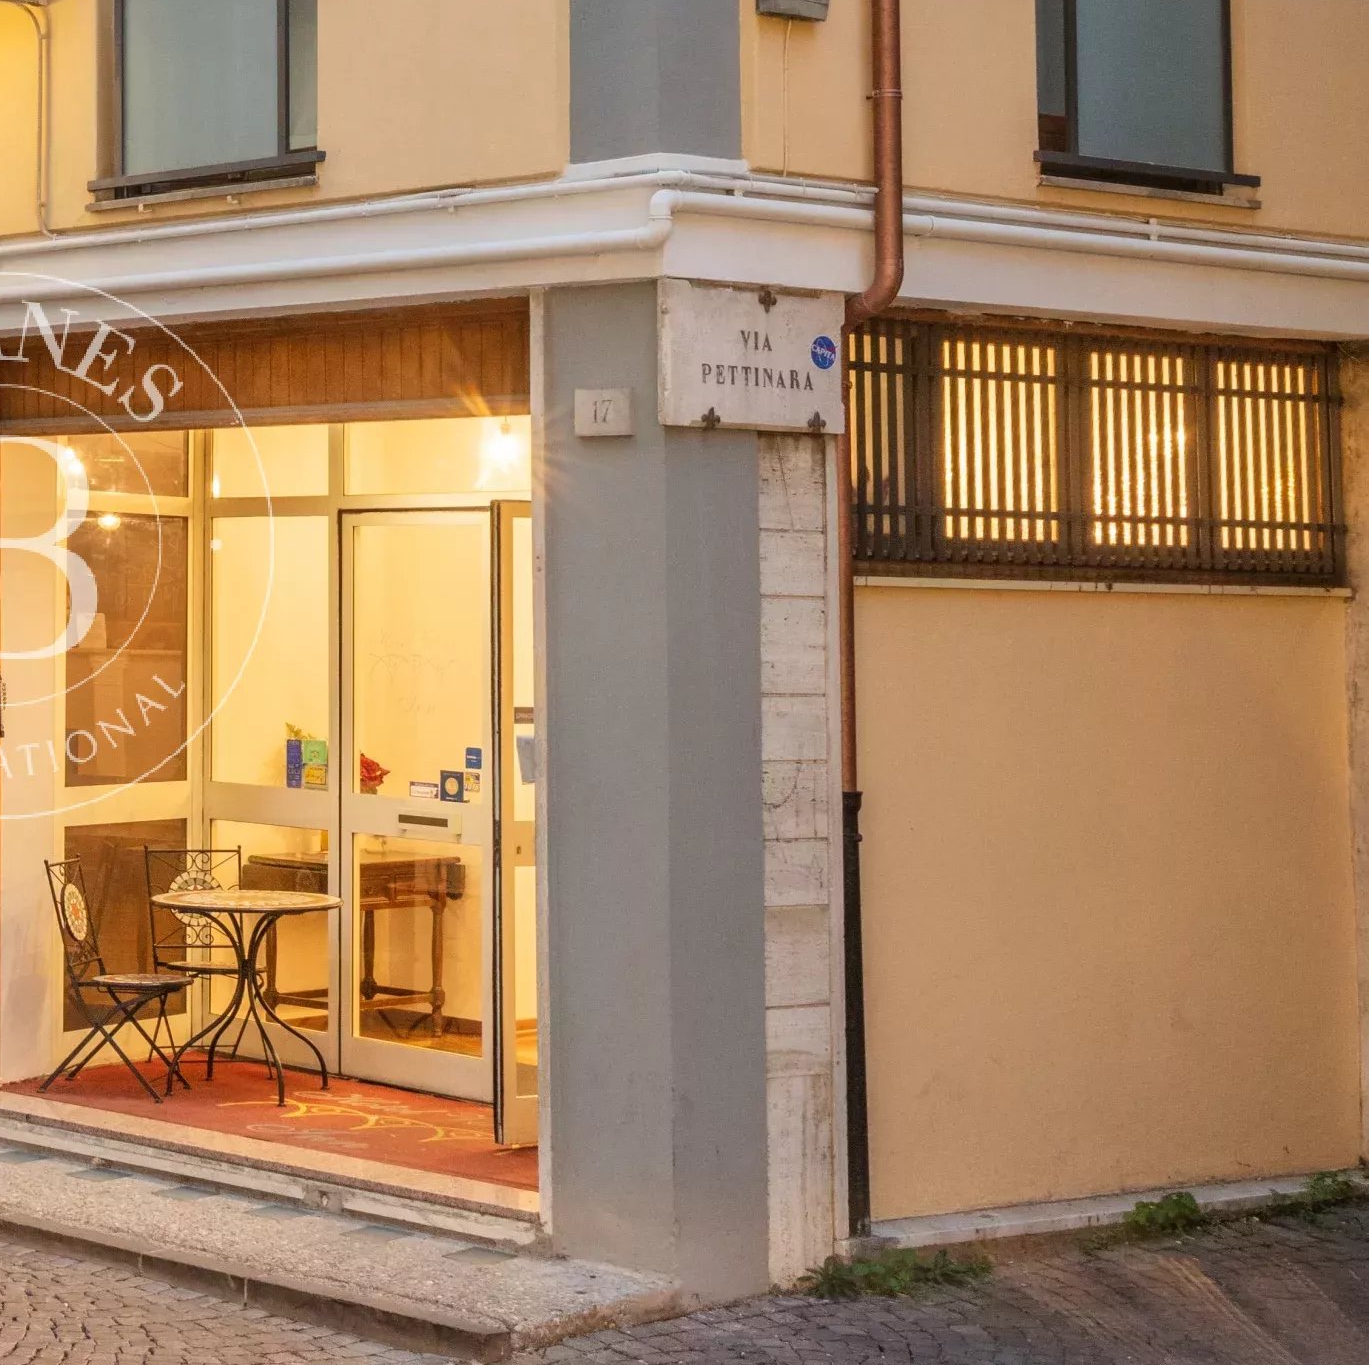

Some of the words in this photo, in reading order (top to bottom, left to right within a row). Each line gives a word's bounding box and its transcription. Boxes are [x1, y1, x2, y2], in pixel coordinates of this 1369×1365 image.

[740, 329, 773, 352] VIA
[701, 363, 814, 391] PETTINARA
[592, 399, 613, 423] 17
